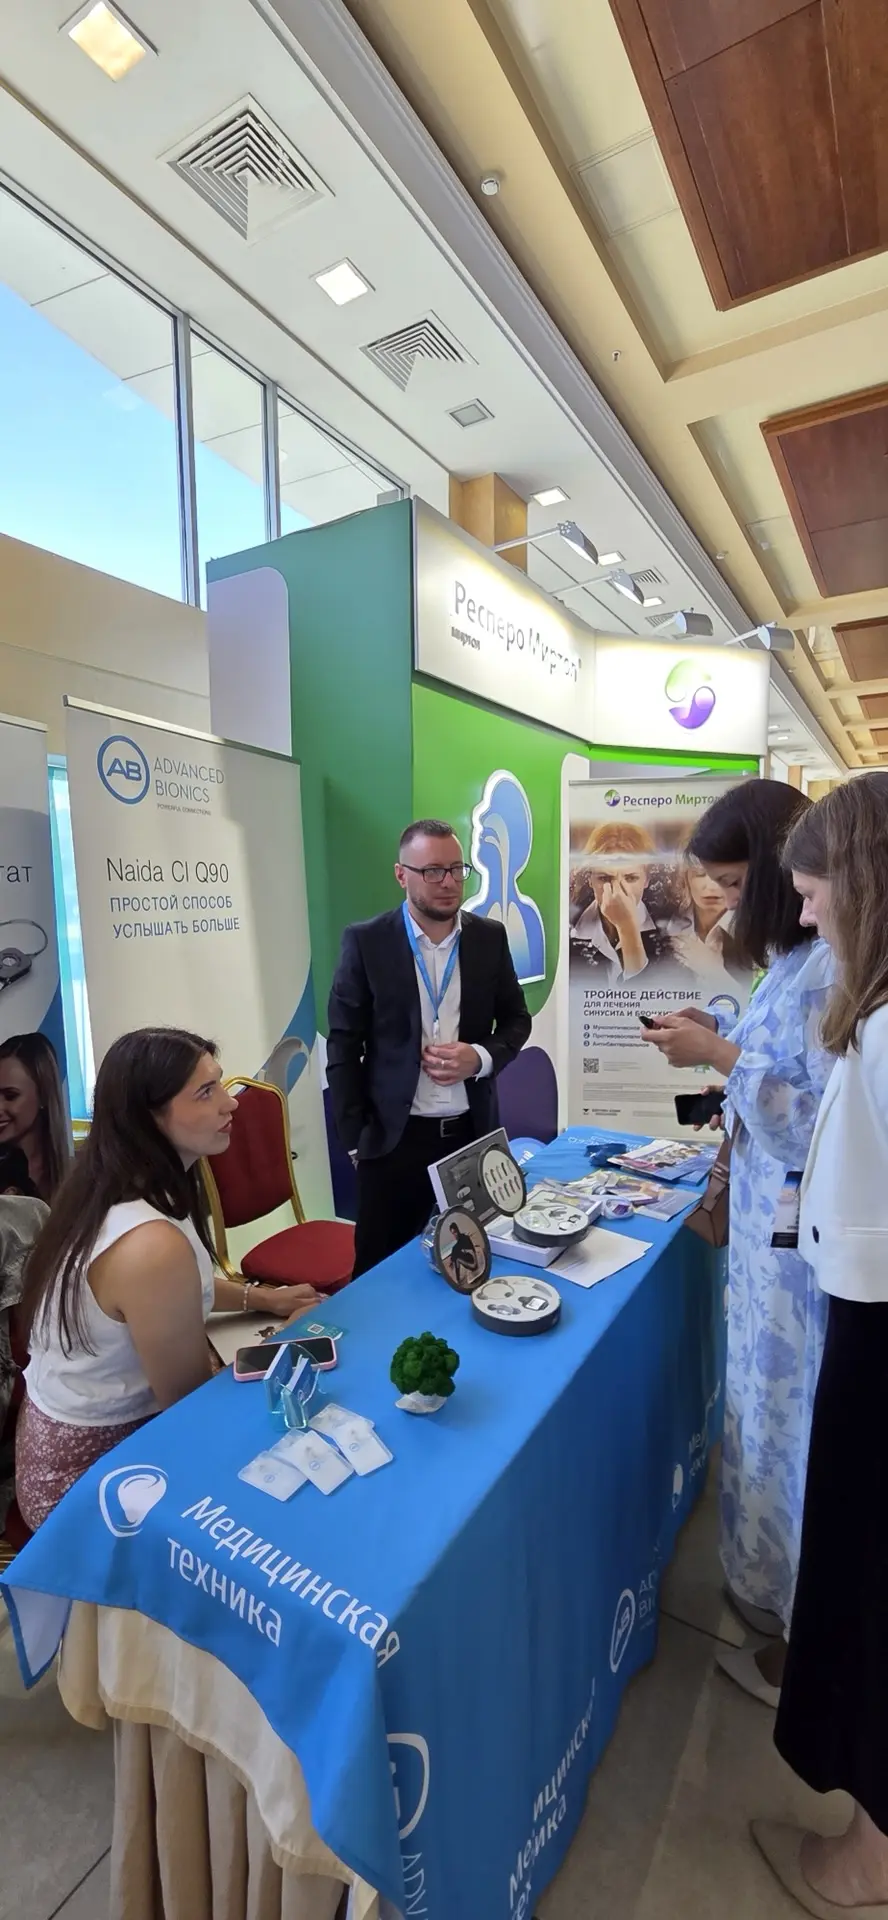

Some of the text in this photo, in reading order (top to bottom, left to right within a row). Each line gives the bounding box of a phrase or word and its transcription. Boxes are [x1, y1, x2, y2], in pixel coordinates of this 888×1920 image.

[454, 580, 525, 652] Респеро
[106, 757, 143, 782] AB
[153, 756, 225, 785] ADVANCED
[155, 779, 210, 804] BIONICS
[623, 795, 673, 808] Респеро
[106, 857, 164, 882] Naida
[195, 861, 229, 884] Q90
[110, 894, 233, 912] ПРОСТОЙ СПОСОБ
[113, 917, 240, 939] УСЛЫШАТЬ БОЛЬШЕ
[584, 988, 702, 1000] ТРОЙНОЕ ДЕЙСТВИЕ
[167, 1537, 282, 1647] техника
[181, 1496, 401, 1669] Медицинская
